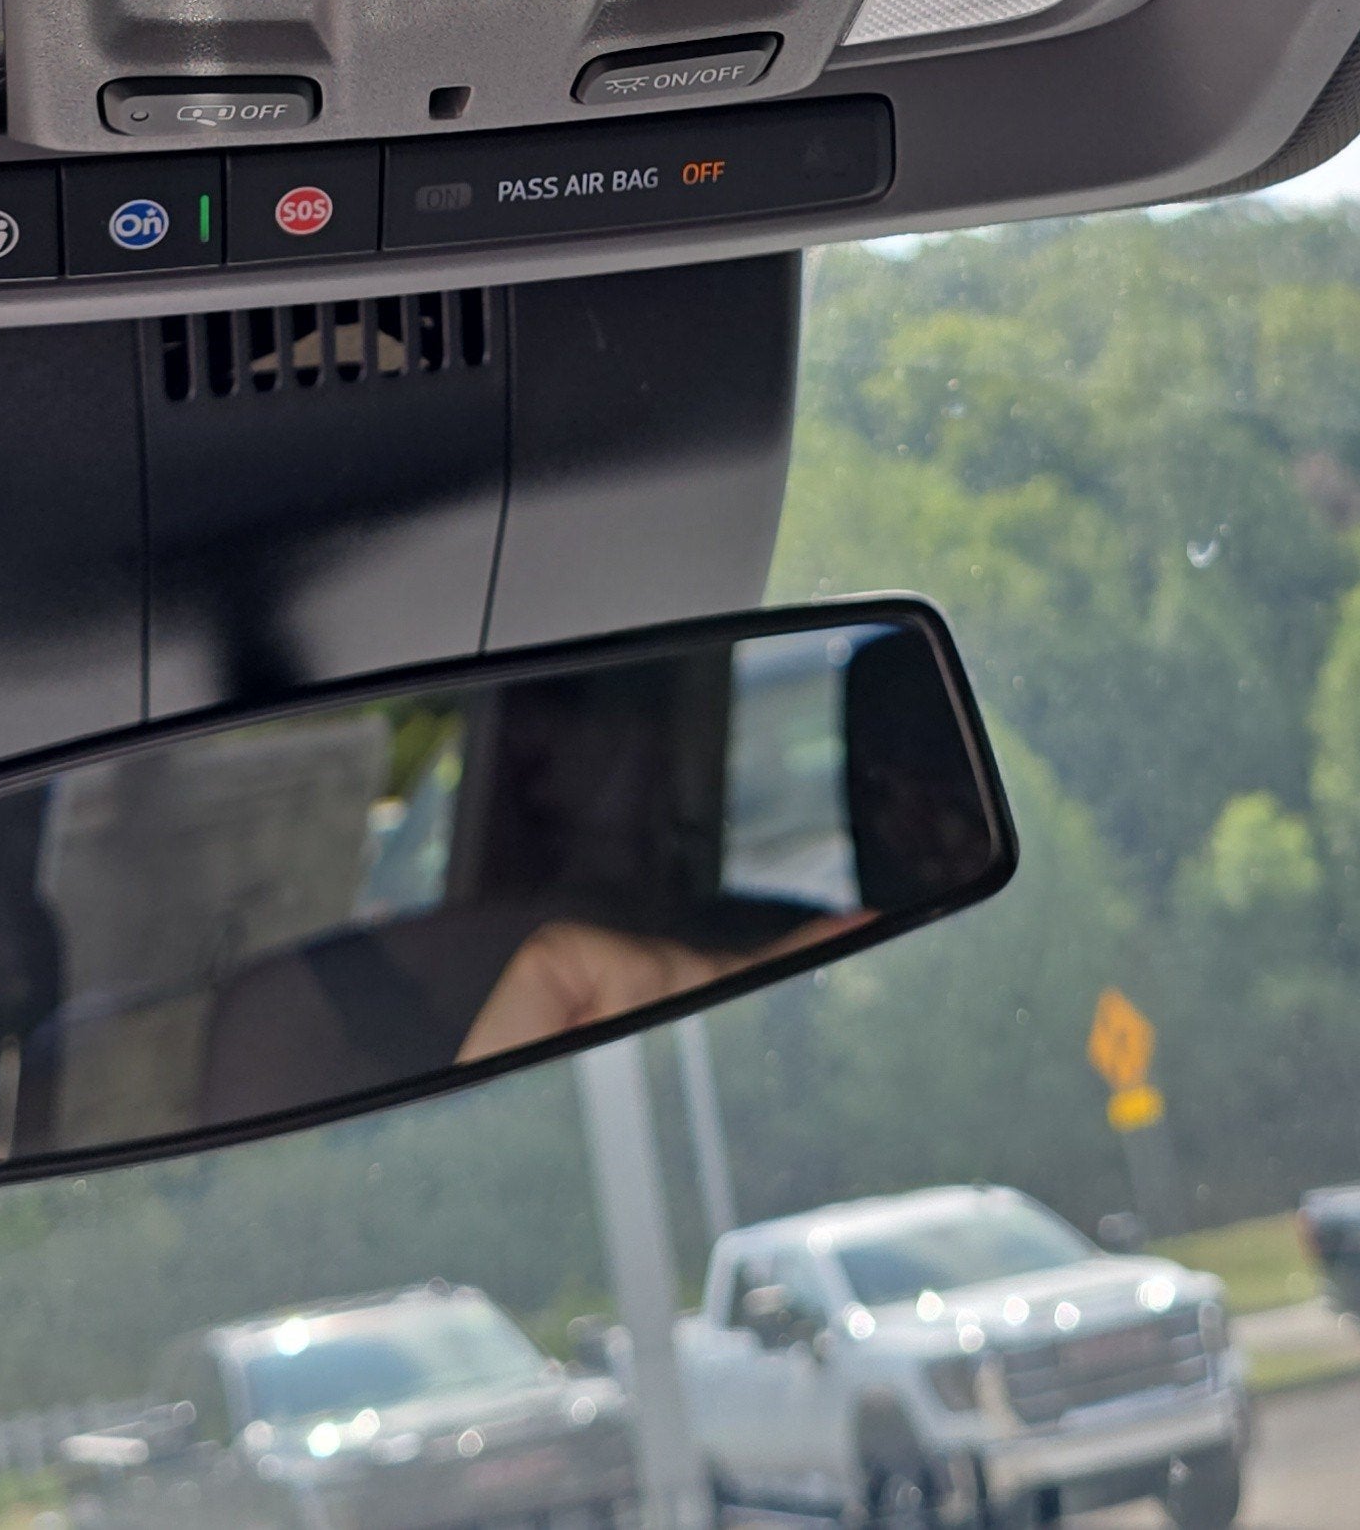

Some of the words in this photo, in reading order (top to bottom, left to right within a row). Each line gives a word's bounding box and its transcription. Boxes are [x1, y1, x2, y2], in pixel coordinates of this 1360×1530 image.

[653, 65, 745, 89] ON/OFF
[240, 104, 288, 120] OFF
[497, 177, 559, 203] PASS
[564, 172, 605, 197] AIR
[612, 167, 659, 193] BAG
[682, 161, 726, 186] OFF
[425, 187, 462, 209] ON
[282, 199, 326, 222] SOS
